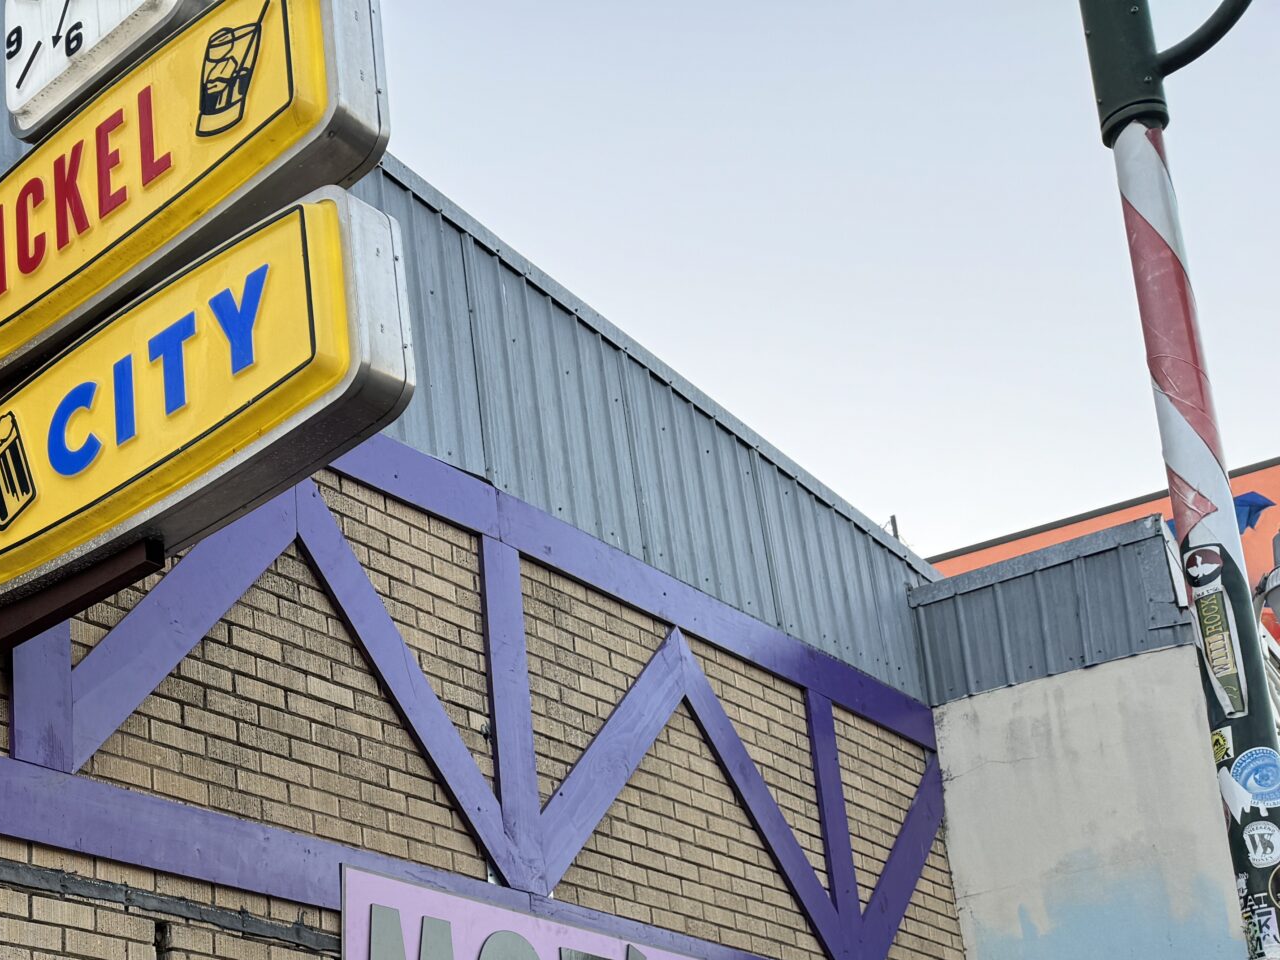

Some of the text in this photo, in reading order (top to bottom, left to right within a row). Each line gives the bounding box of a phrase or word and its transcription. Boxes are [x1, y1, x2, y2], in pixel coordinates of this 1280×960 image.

[5, 25, 23, 61] 9
[64, 21, 84, 58] 6
[46, 263, 270, 477] CITY
